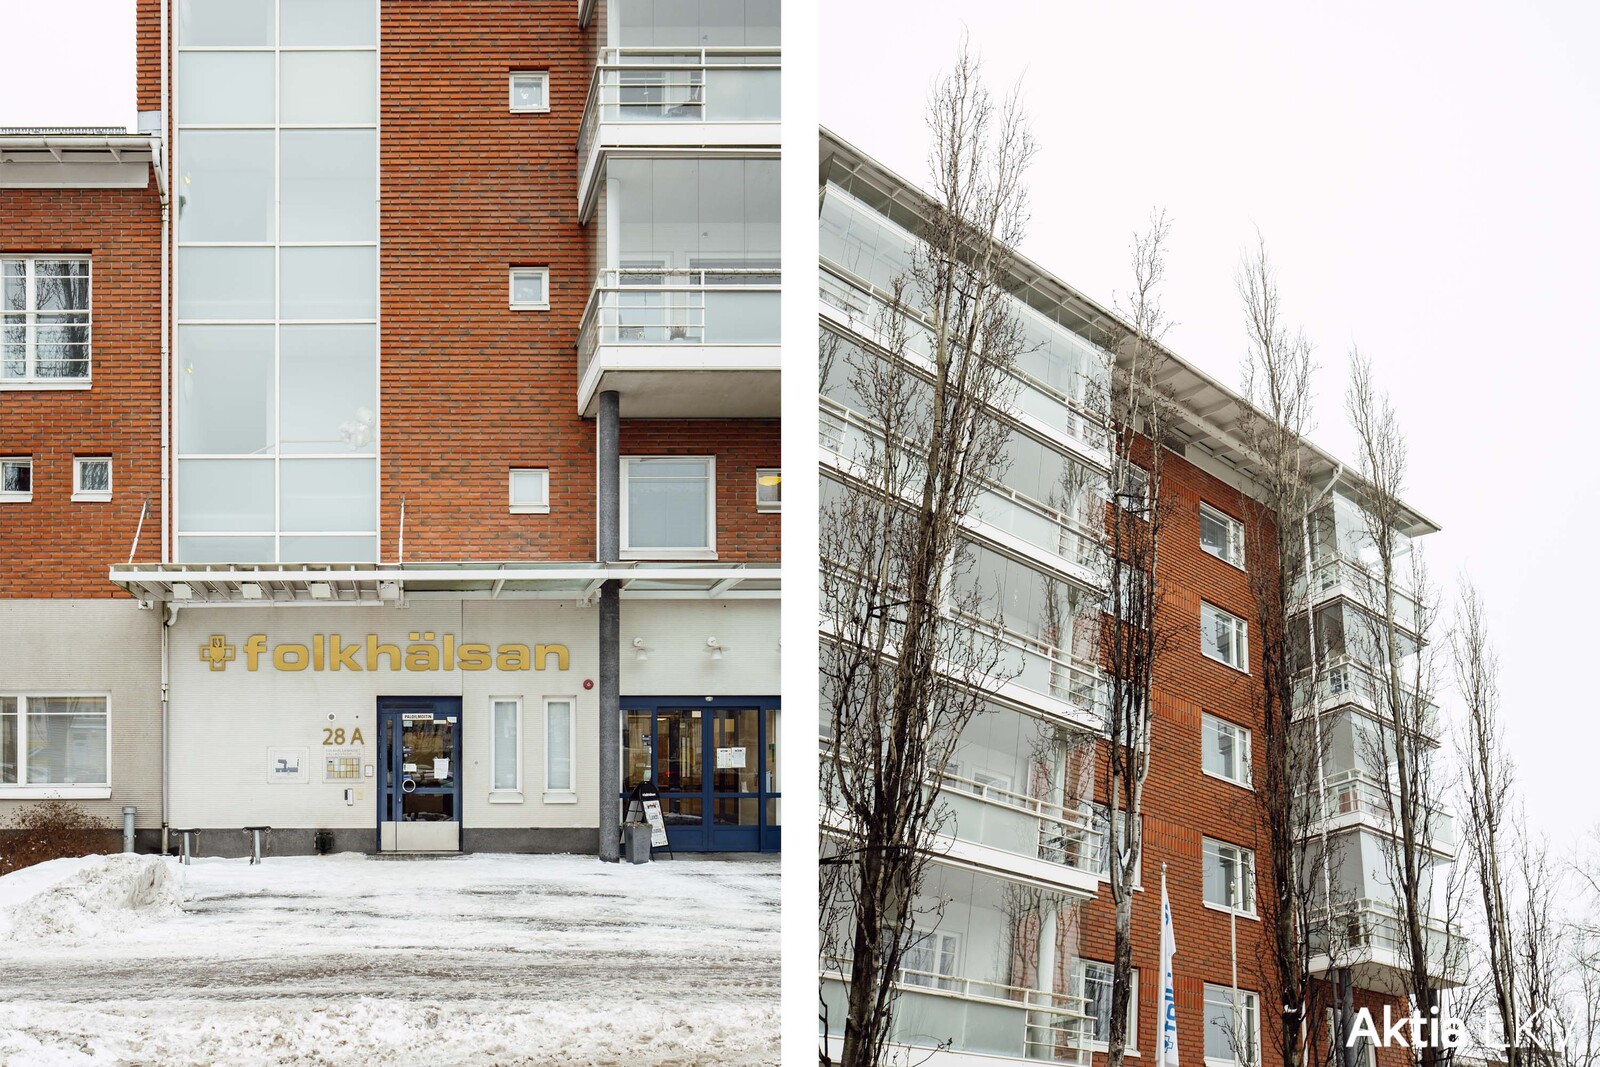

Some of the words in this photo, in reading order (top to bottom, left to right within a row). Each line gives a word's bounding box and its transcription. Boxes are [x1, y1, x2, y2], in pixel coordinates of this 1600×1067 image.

[243, 632, 570, 672] folkhälsan
[322, 728, 345, 745] 28
[350, 727, 364, 745] A
